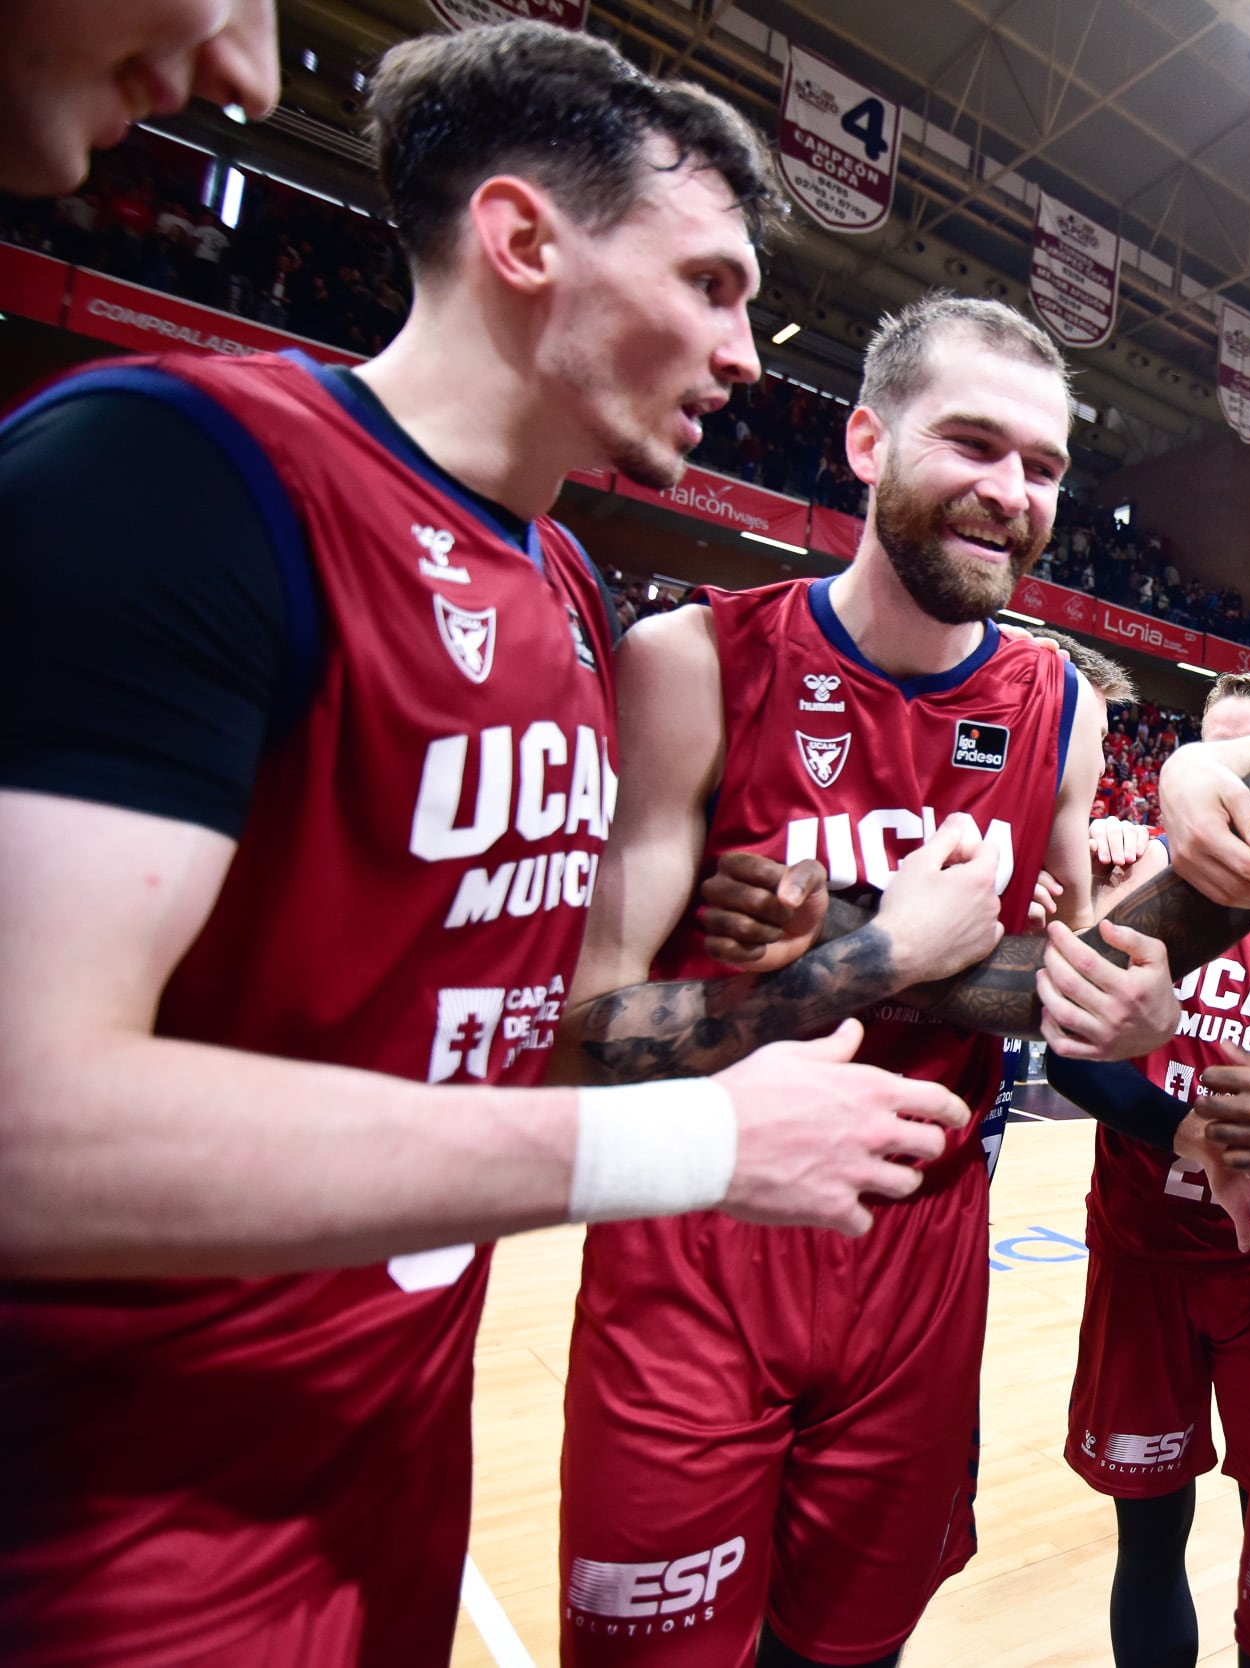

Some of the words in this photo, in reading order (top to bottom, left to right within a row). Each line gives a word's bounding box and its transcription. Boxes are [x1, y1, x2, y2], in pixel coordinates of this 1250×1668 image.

[841, 97, 888, 162] 4
[794, 130, 880, 185] CAMPEÓN
[812, 153, 858, 187] COPA
[733, 510, 769, 530] viajes
[1104, 609, 1163, 647] Lunia
[956, 749, 1002, 765] endesa
[959, 735, 977, 750] liga
[600, 1536, 746, 1619] ESP
